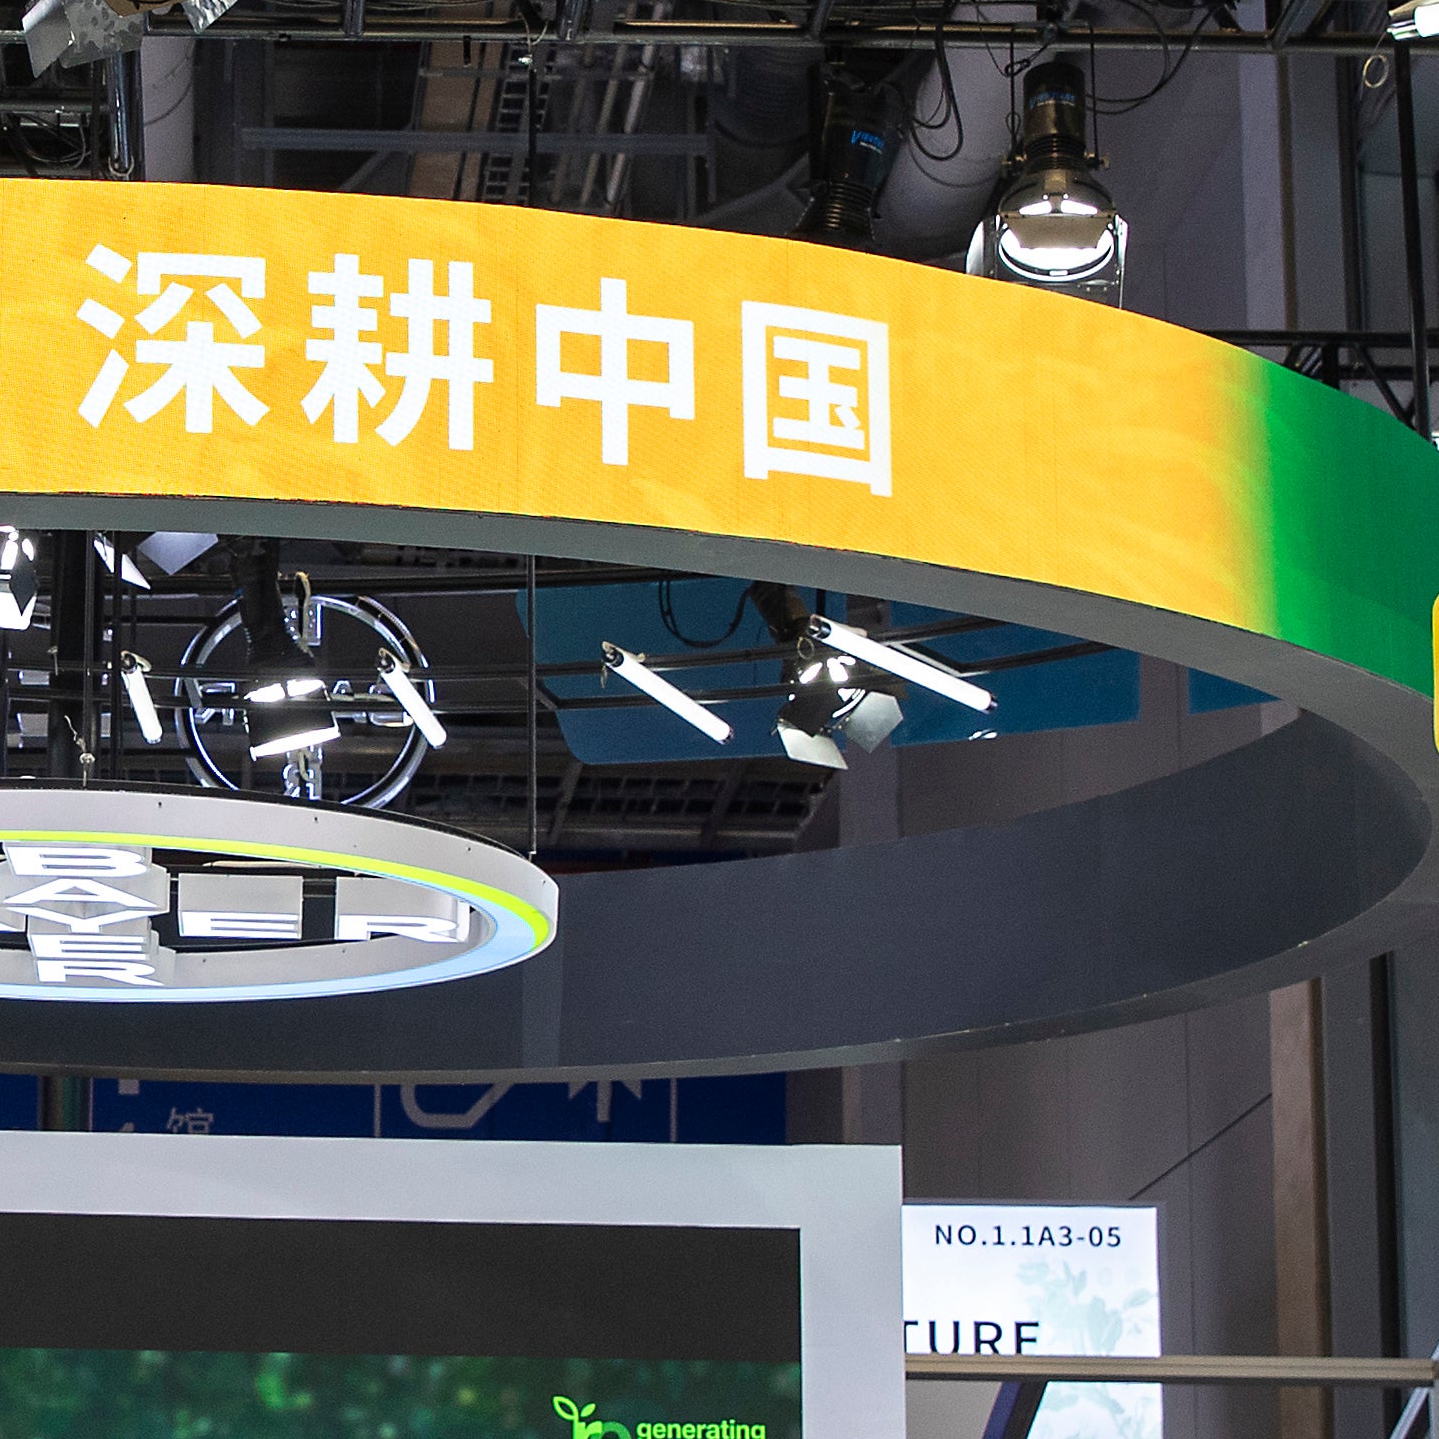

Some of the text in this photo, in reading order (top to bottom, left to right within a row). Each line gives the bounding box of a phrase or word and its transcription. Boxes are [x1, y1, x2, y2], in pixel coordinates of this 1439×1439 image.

[76, 248, 898, 497] 深耕中国
[933, 1222, 1123, 1249] NO.1.1A3-05
